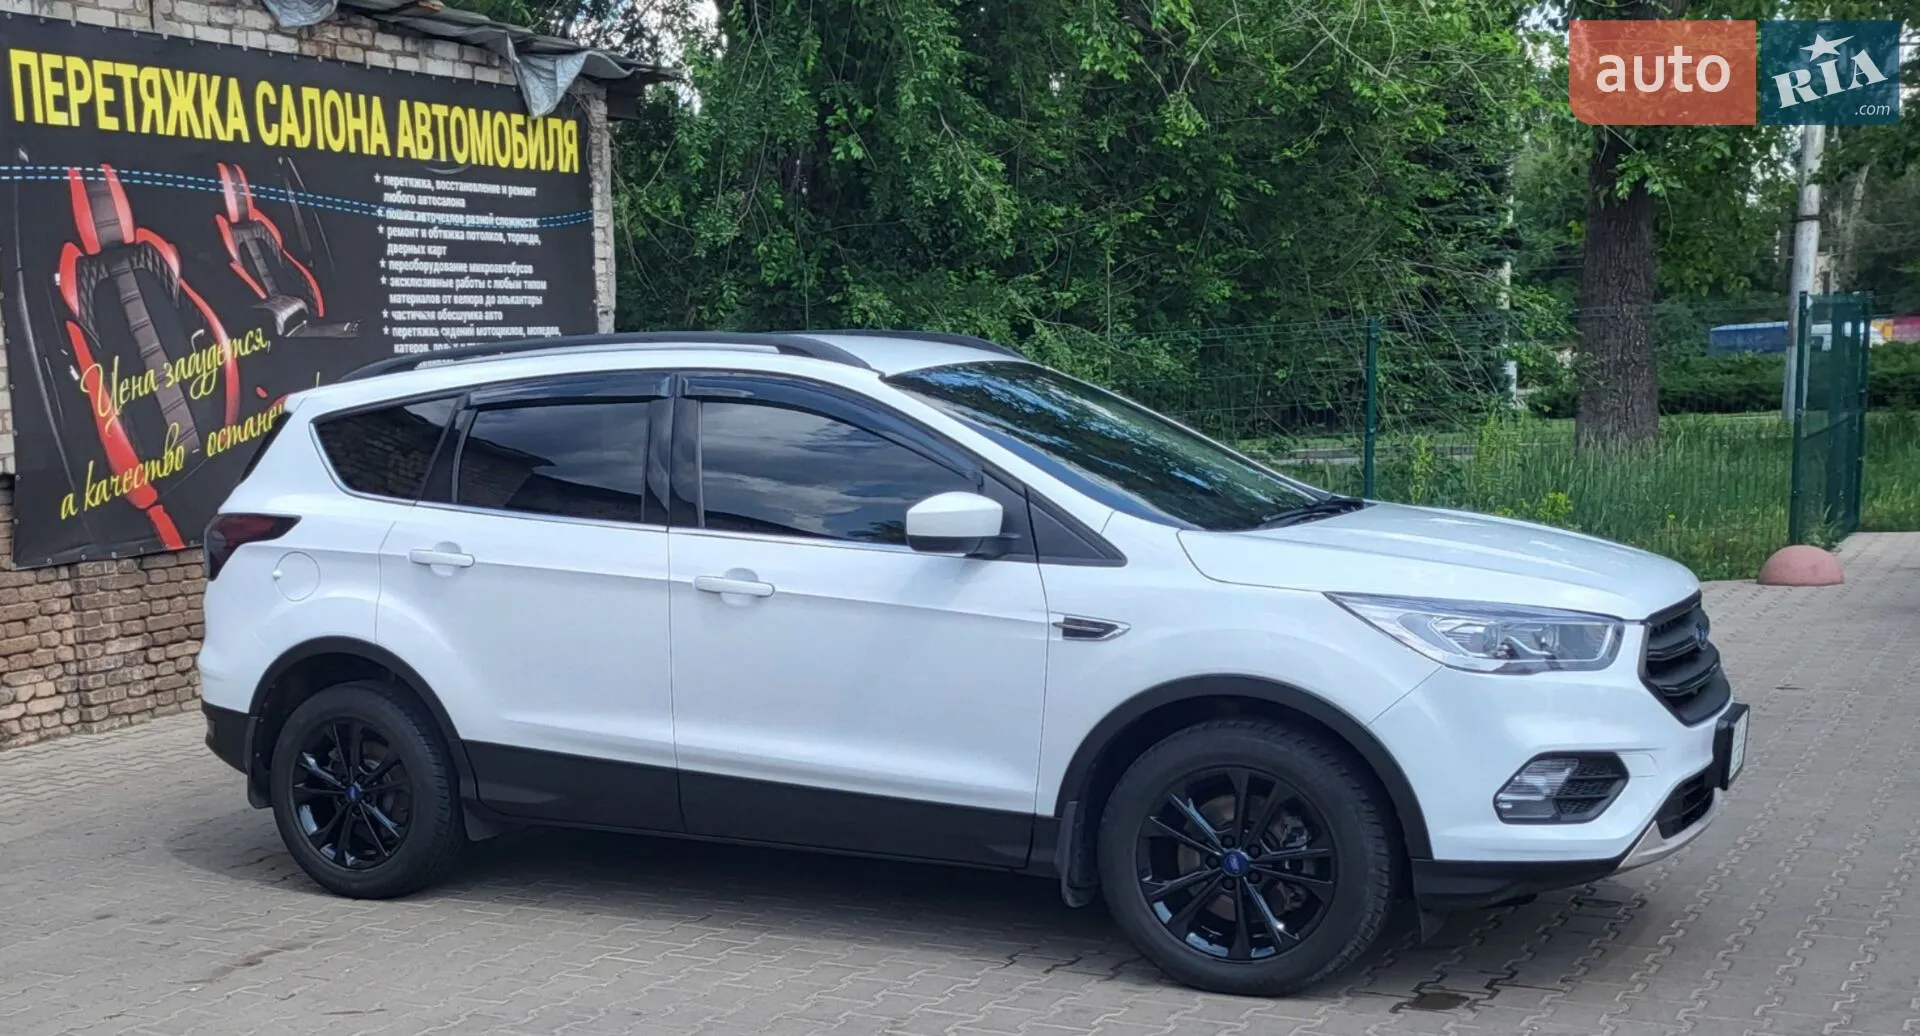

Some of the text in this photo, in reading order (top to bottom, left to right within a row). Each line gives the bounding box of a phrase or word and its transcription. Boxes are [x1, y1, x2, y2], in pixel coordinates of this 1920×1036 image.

[9, 48, 579, 174] ПЕРЕТЯЖКА САЛОНА АВТОМОБИЛЯ
[383, 175, 434, 191] перетяжка,
[435, 180, 500, 194] восстановление
[508, 186, 537, 198] ремонт
[383, 190, 466, 208] любого автосалона
[387, 226, 419, 240] ремонт
[428, 226, 465, 240] обтяжка
[466, 231, 506, 244] потолков,
[507, 233, 542, 246] торпедо,
[387, 243, 448, 258] дверных карт
[388, 258, 534, 276] переоборудование микроавтобусов
[389, 277, 454, 289] эксклюзивные
[455, 276, 486, 292] работы
[493, 277, 522, 290] любым
[523, 280, 547, 290] типом
[389, 294, 441, 307] материалов
[442, 295, 452, 304] от
[453, 295, 484, 308] велюра
[484, 295, 496, 308] до
[484, 311, 503, 320] авто
[392, 327, 439, 340] перетяжка
[80, 329, 271, 437] Цена забудется,
[61, 492, 78, 519] а
[84, 422, 184, 511] качество
